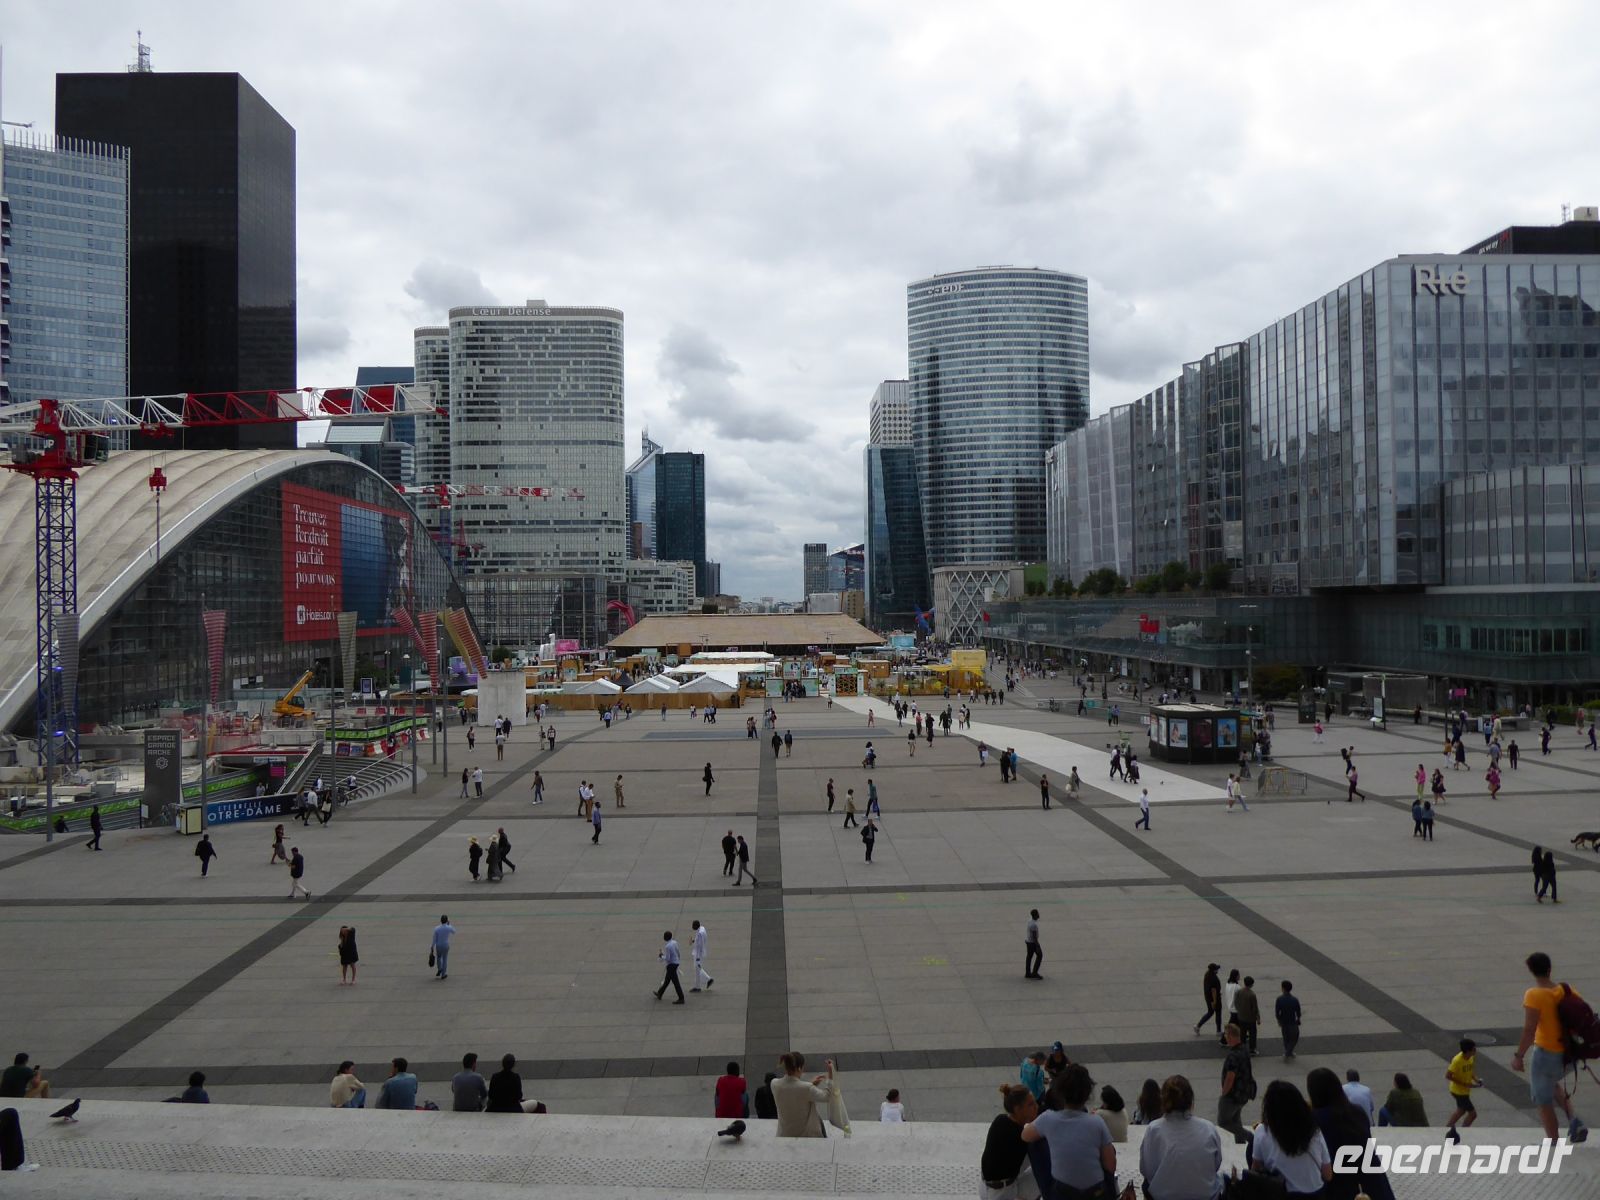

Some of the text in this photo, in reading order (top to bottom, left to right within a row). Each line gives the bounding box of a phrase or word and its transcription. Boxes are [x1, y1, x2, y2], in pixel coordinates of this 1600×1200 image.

[293, 504, 328, 526] Trouvez
[296, 546, 325, 568] parfait
[296, 572, 336, 589] pour vous
[207, 804, 282, 821] OTRE-DAME
